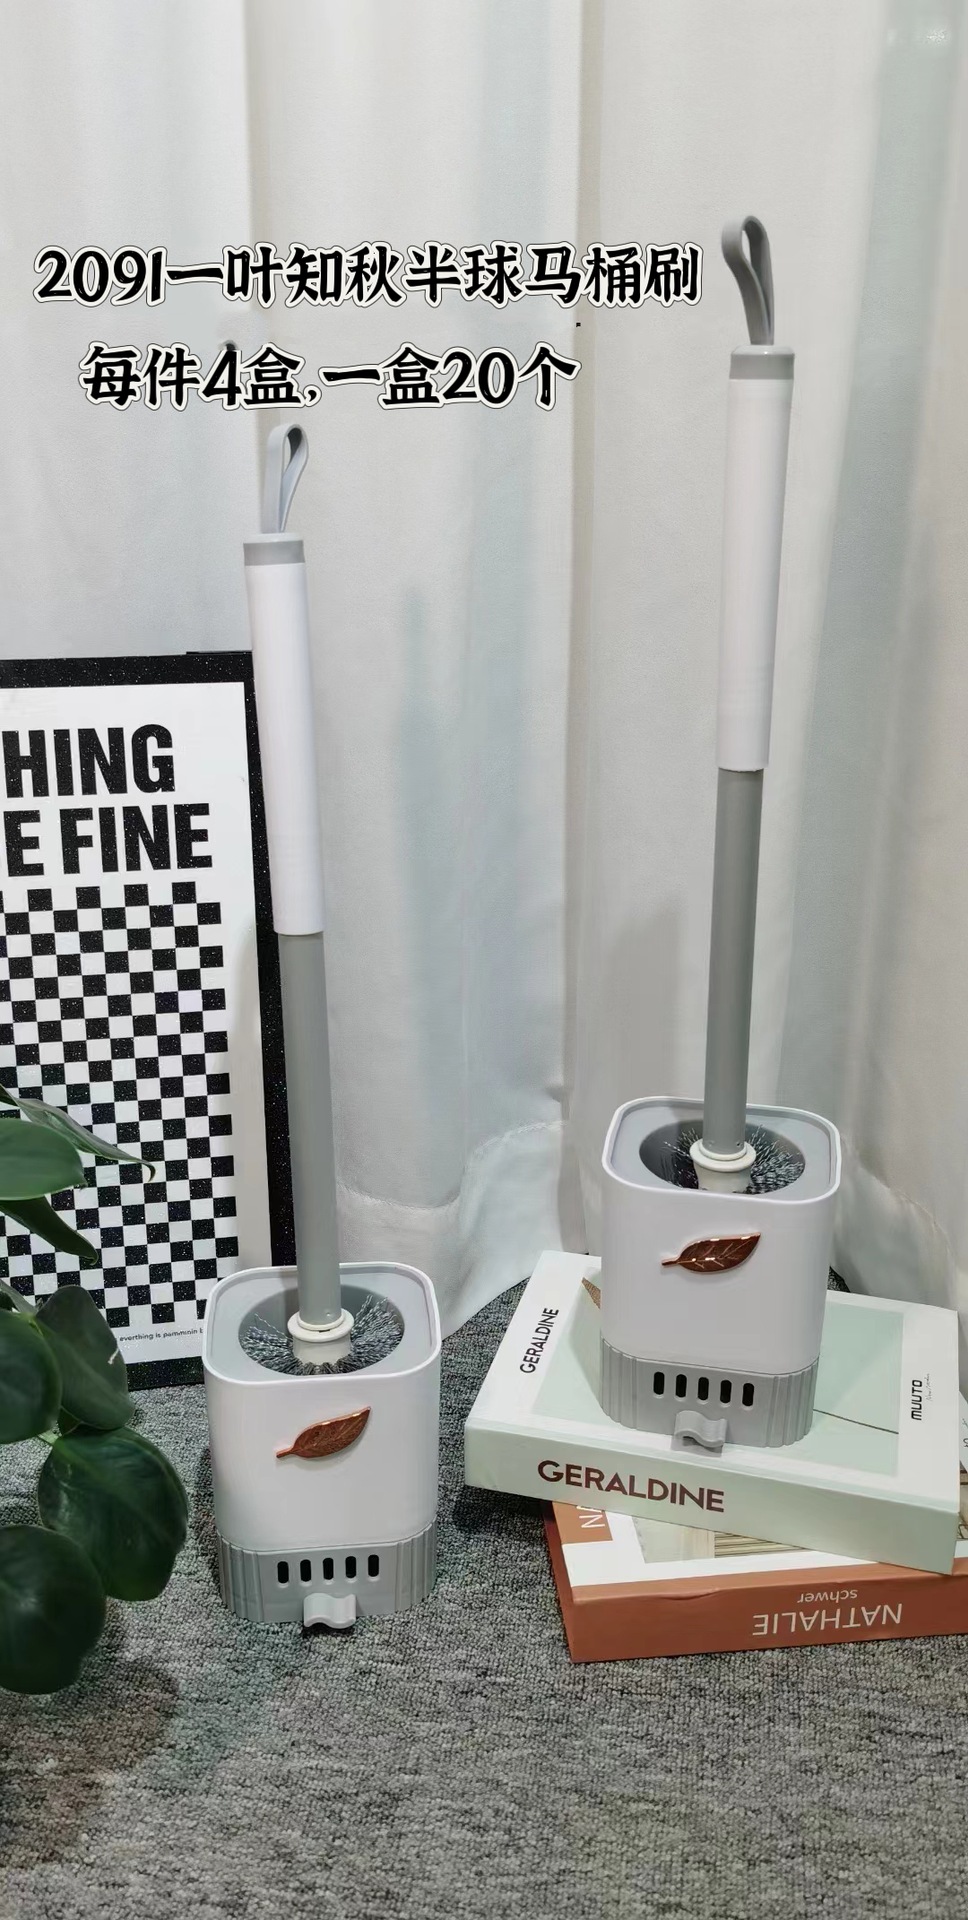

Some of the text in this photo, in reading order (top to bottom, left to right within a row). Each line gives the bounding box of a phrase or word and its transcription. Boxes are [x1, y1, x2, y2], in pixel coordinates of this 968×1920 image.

[2, 723, 175, 798] HING
[3, 803, 213, 877] E FINE
[519, 1307, 560, 1374] GERALDINE
[911, 1379, 923, 1421] MUUTO
[537, 1459, 725, 1514] GERALDINE
[752, 1603, 903, 1636] NATHALIE
[797, 1589, 858, 1604] schwer
